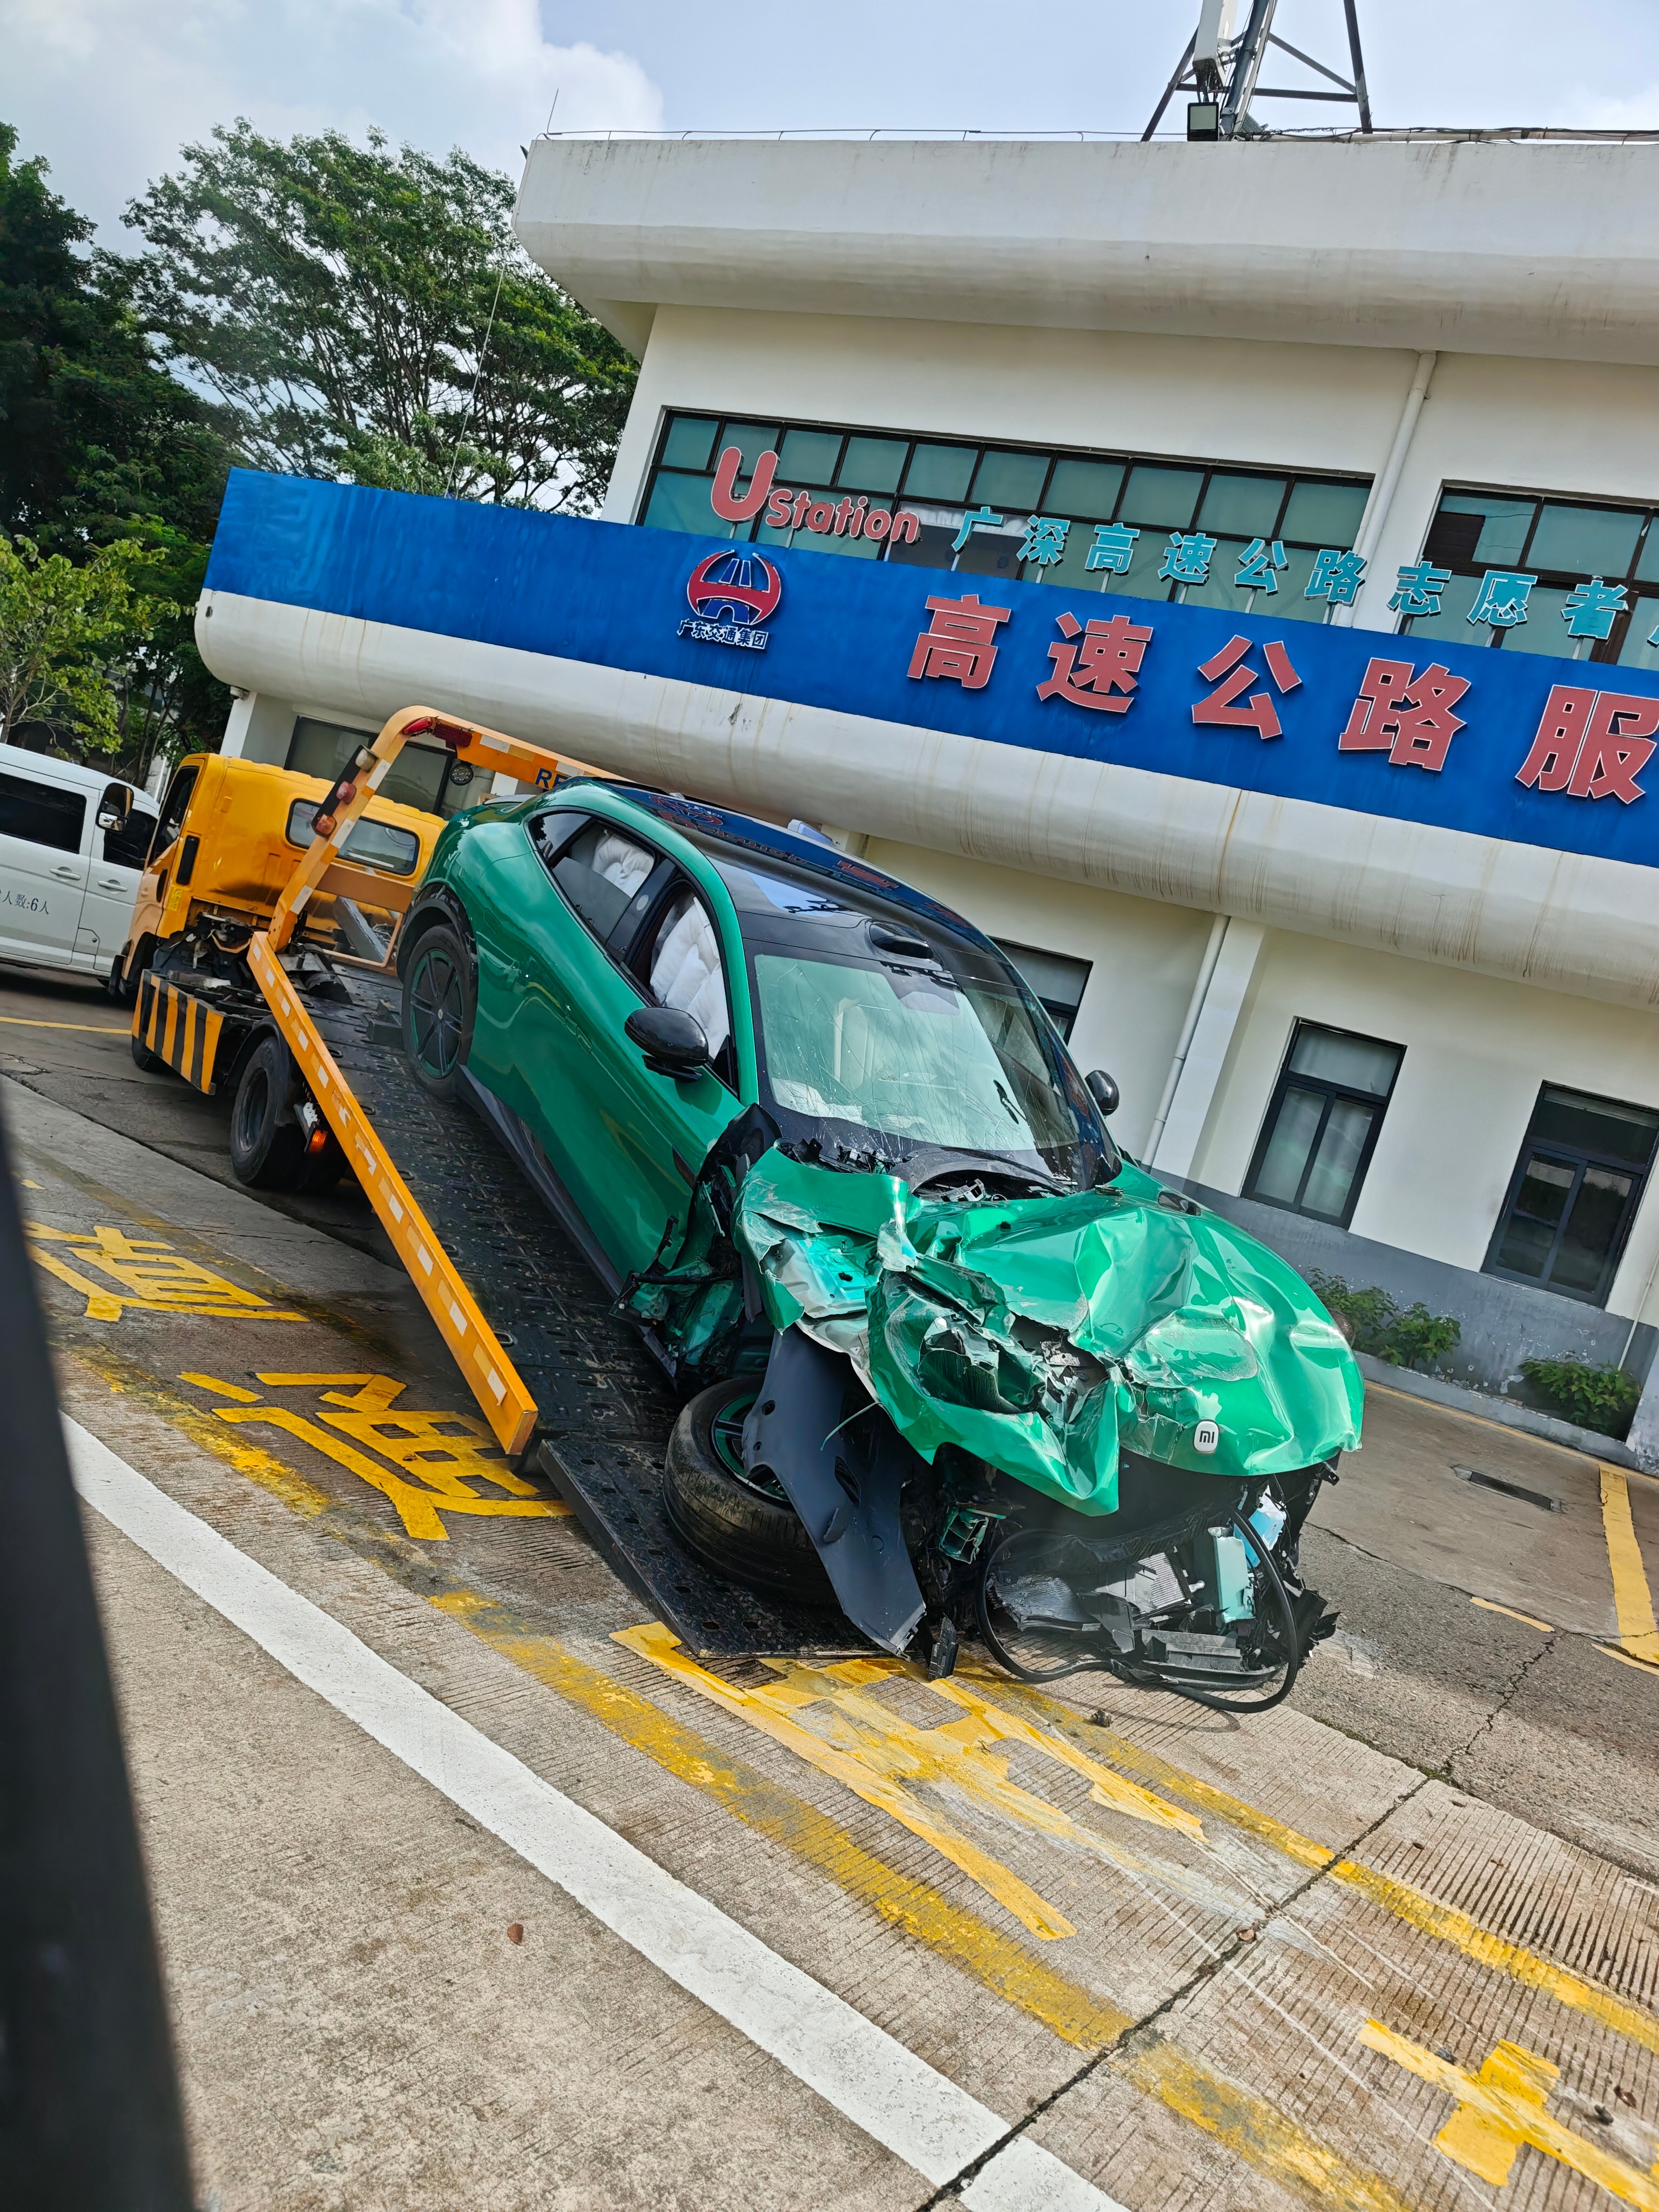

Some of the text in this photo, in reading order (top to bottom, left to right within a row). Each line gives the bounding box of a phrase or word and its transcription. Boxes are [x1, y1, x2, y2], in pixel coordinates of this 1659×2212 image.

[951, 505, 1659, 648] 广深高速公路志愿者
[677, 618, 769, 650] 广东交通集团
[907, 594, 1659, 805] 高速公路服
[0, 889, 50, 915] 人数:6人
